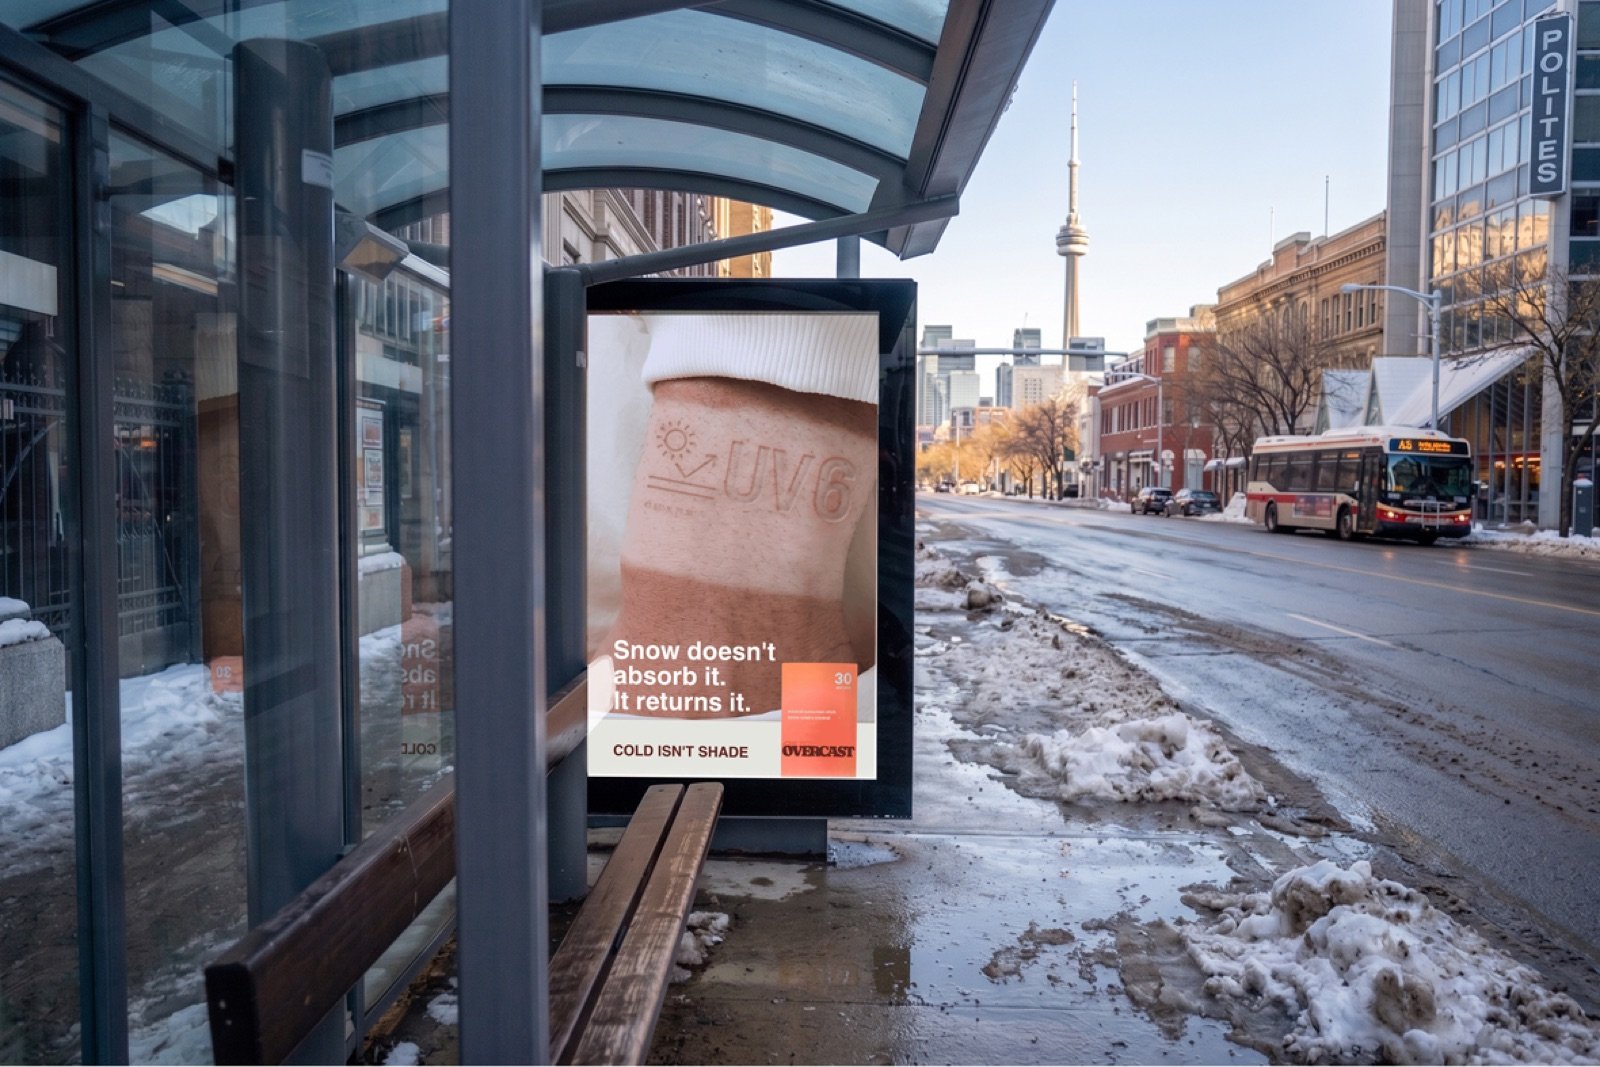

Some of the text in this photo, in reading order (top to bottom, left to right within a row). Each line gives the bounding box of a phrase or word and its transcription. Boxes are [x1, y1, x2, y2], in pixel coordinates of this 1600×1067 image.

[1537, 29, 1563, 183] POLITES
[613, 639, 777, 661] Snow doesn't
[613, 665, 727, 686] absorb it.
[834, 672, 852, 685] 30
[613, 691, 751, 712] It returns it.
[613, 744, 749, 759] COLD ISN'T SHADE
[782, 745, 855, 757] OVERCAST
